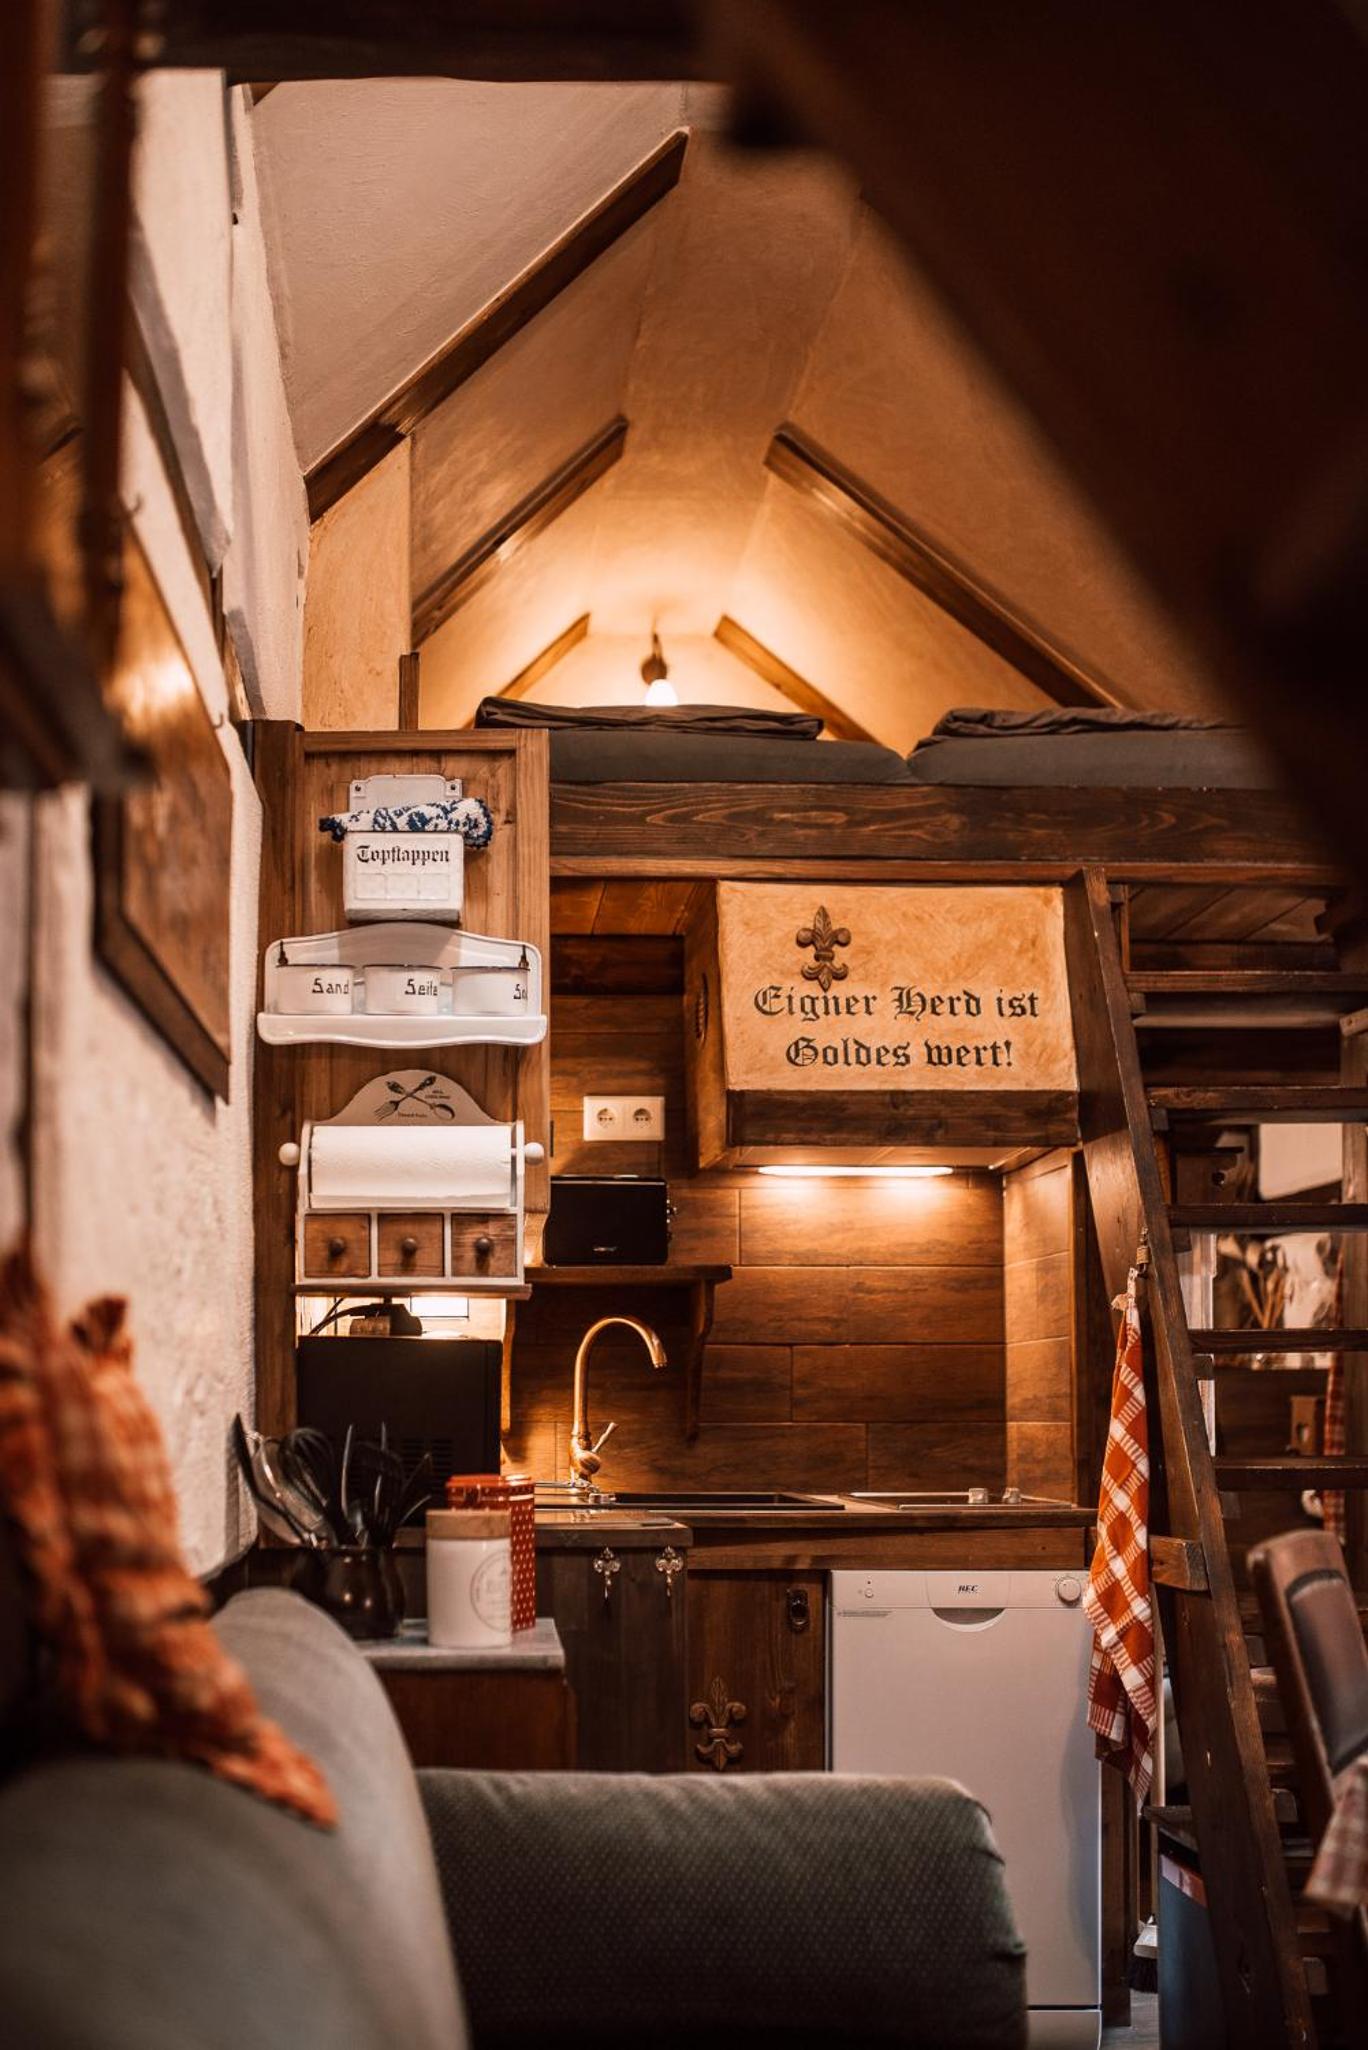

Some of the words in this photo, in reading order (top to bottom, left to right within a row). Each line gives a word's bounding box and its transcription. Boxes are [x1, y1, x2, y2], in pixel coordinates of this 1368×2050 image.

[356, 844, 450, 866] Topflappen
[311, 977, 350, 994] Sand
[753, 984, 878, 1022] Eigner
[890, 983, 983, 1021] Herd
[995, 988, 1040, 1018] ist
[785, 1036, 911, 1068] Goldes
[924, 1039, 1014, 1068] wert!
